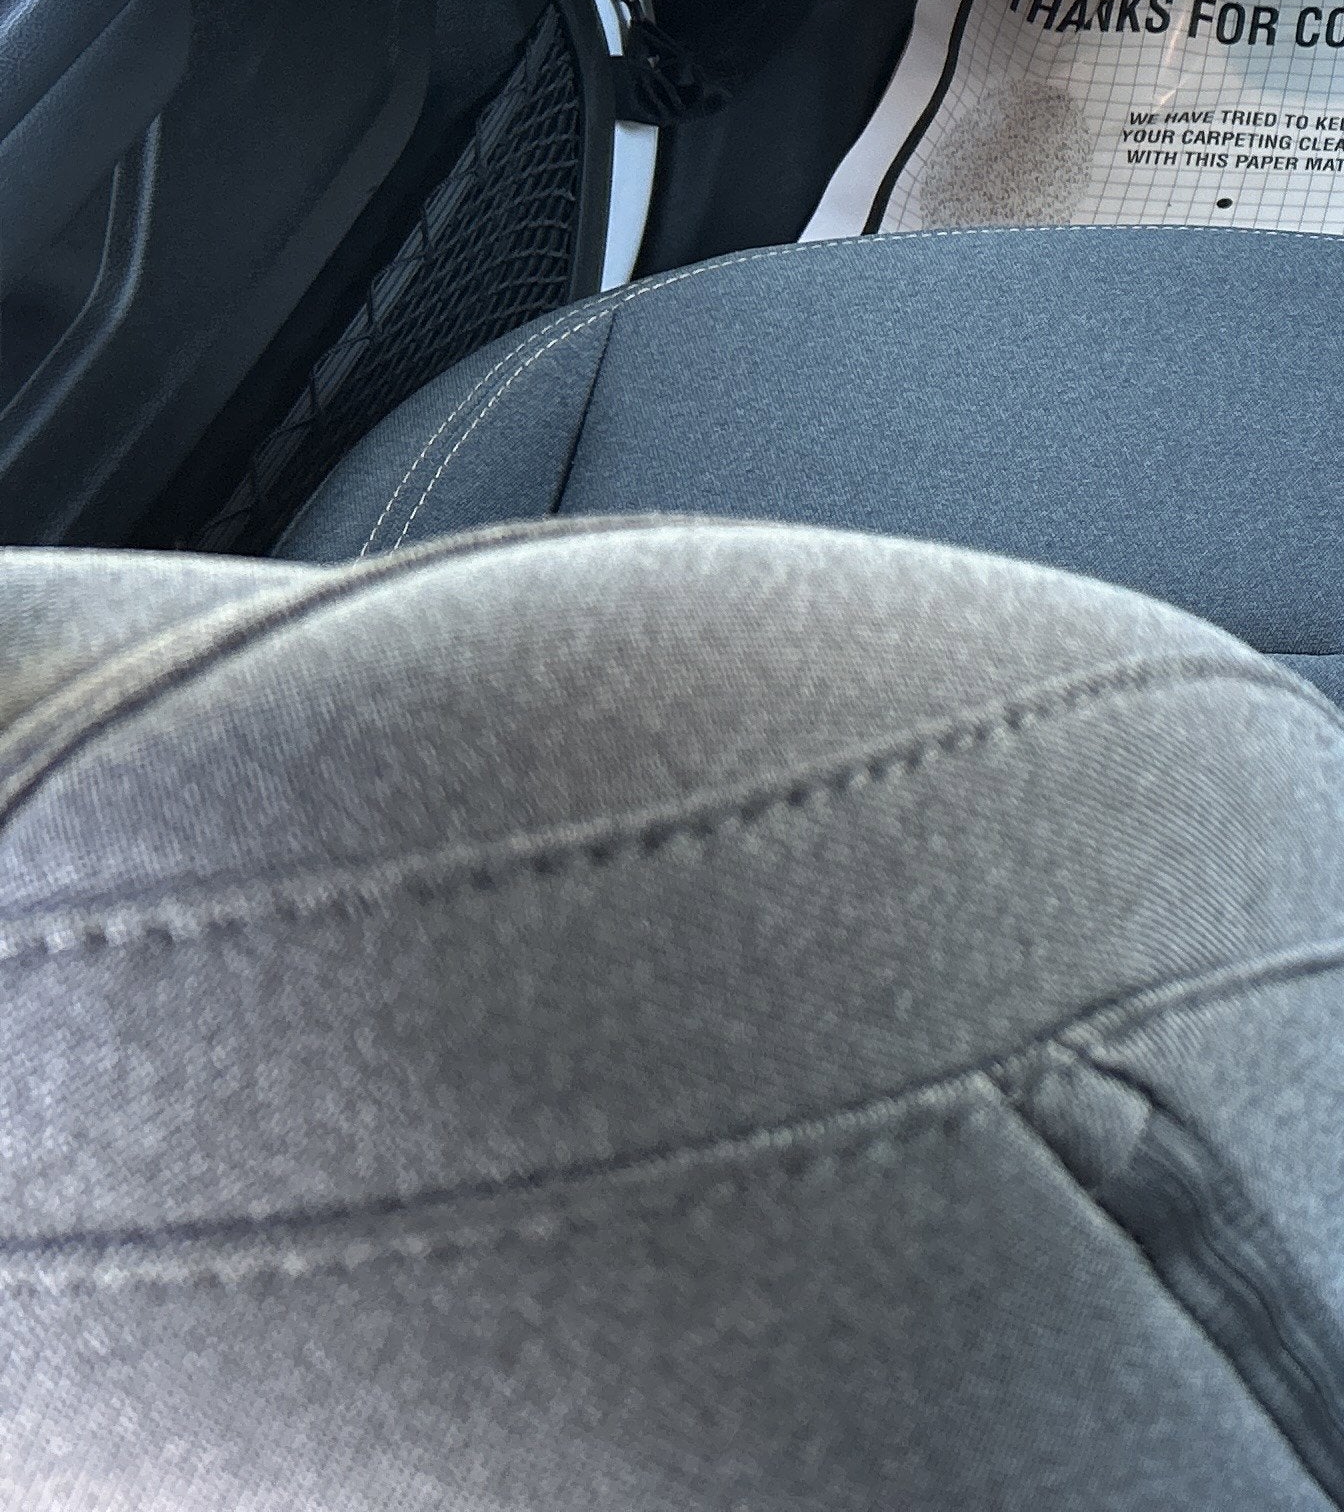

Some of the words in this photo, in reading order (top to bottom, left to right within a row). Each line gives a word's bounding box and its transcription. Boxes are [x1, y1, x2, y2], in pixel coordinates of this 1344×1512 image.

[1130, 112, 1158, 125] WE
[1164, 110, 1214, 125] HAVE
[1221, 110, 1277, 127] TRIED
[1285, 114, 1308, 130] TO
[1122, 129, 1175, 144] YOUR
[1181, 130, 1291, 149] CARPETING
[1127, 150, 1177, 165] WITH
[1185, 152, 1228, 168] THIS
[1235, 154, 1298, 171] PAPER
